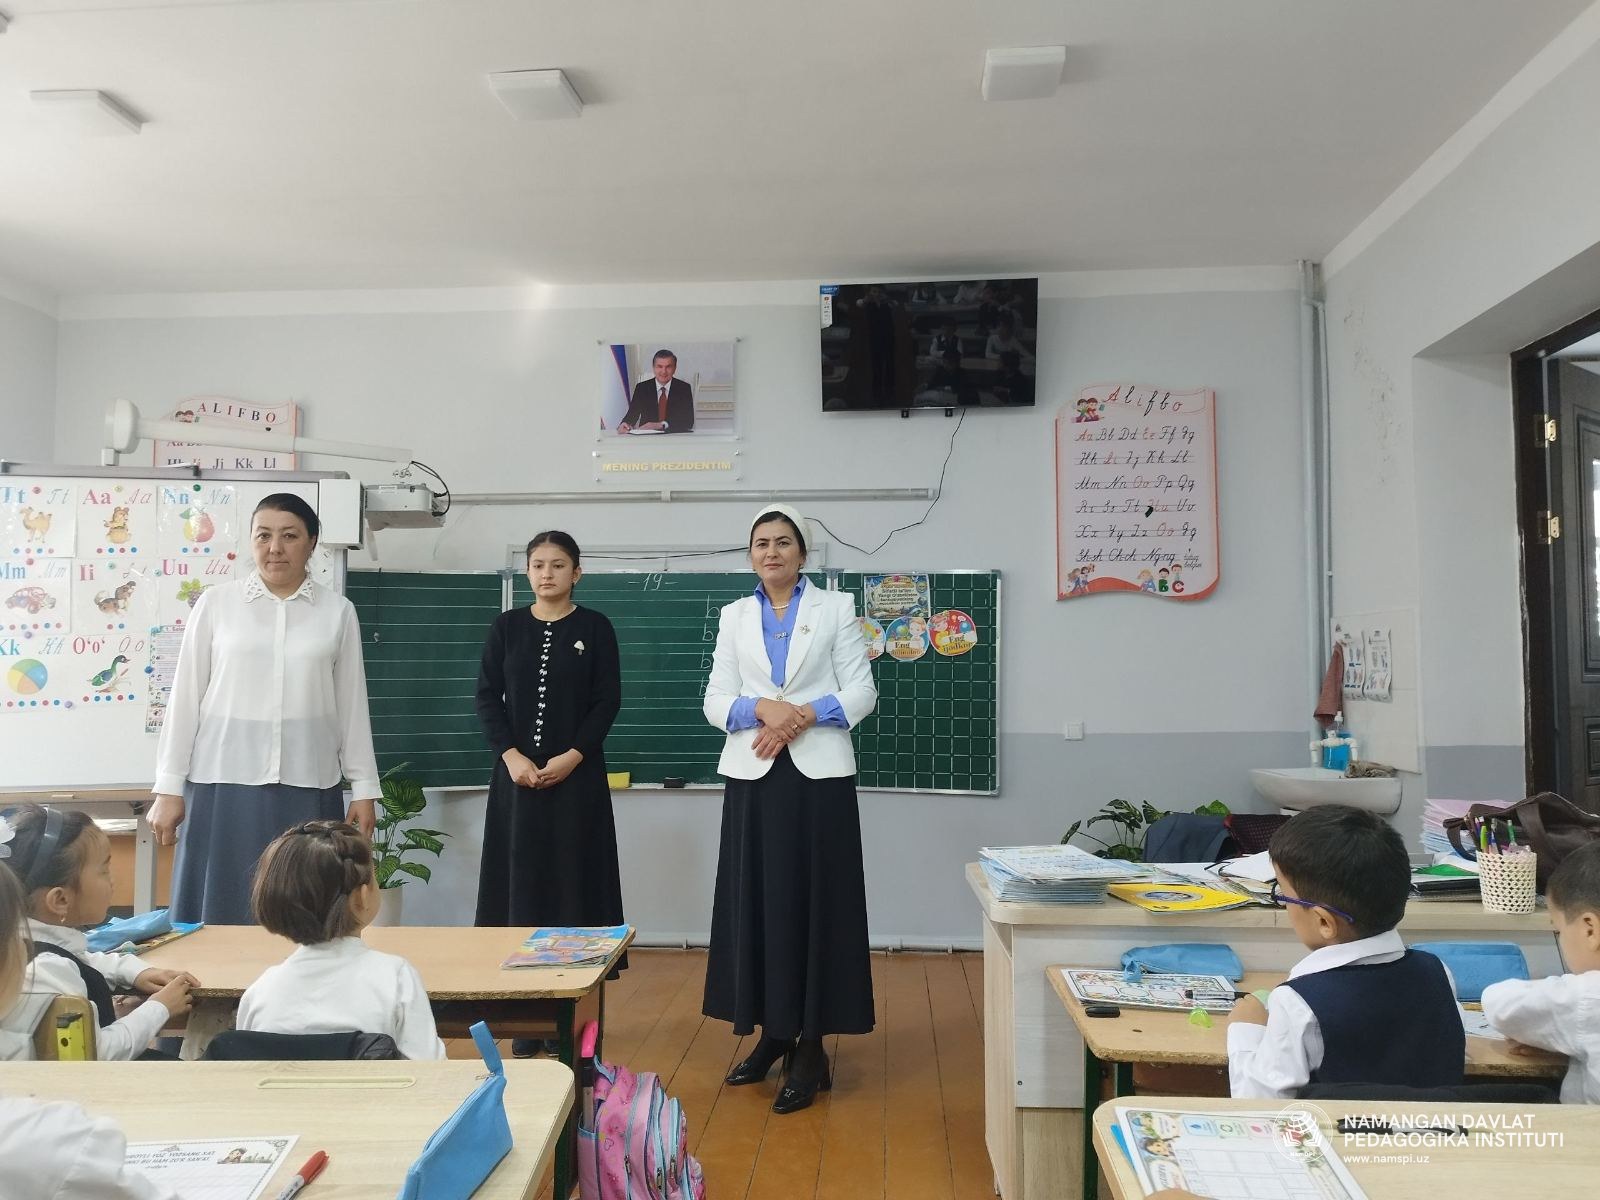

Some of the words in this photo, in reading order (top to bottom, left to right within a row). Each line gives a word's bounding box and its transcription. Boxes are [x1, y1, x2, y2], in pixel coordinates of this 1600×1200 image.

[197, 402, 276, 424] ALIFBO
[1075, 429, 1093, 442] Aa
[1095, 427, 1115, 442] Bb
[1118, 427, 1139, 441] Dd
[212, 458, 225, 470] Jj
[235, 457, 254, 469] Kk
[602, 462, 649, 472] MENING
[651, 461, 733, 472] PREZIDENTIM
[1075, 475, 1100, 490] Mm
[1106, 475, 1127, 489] Nn
[82, 488, 112, 505] Aa
[80, 564, 96, 581] Ii
[162, 559, 188, 576] Uu
[895, 641, 910, 650] Eng
